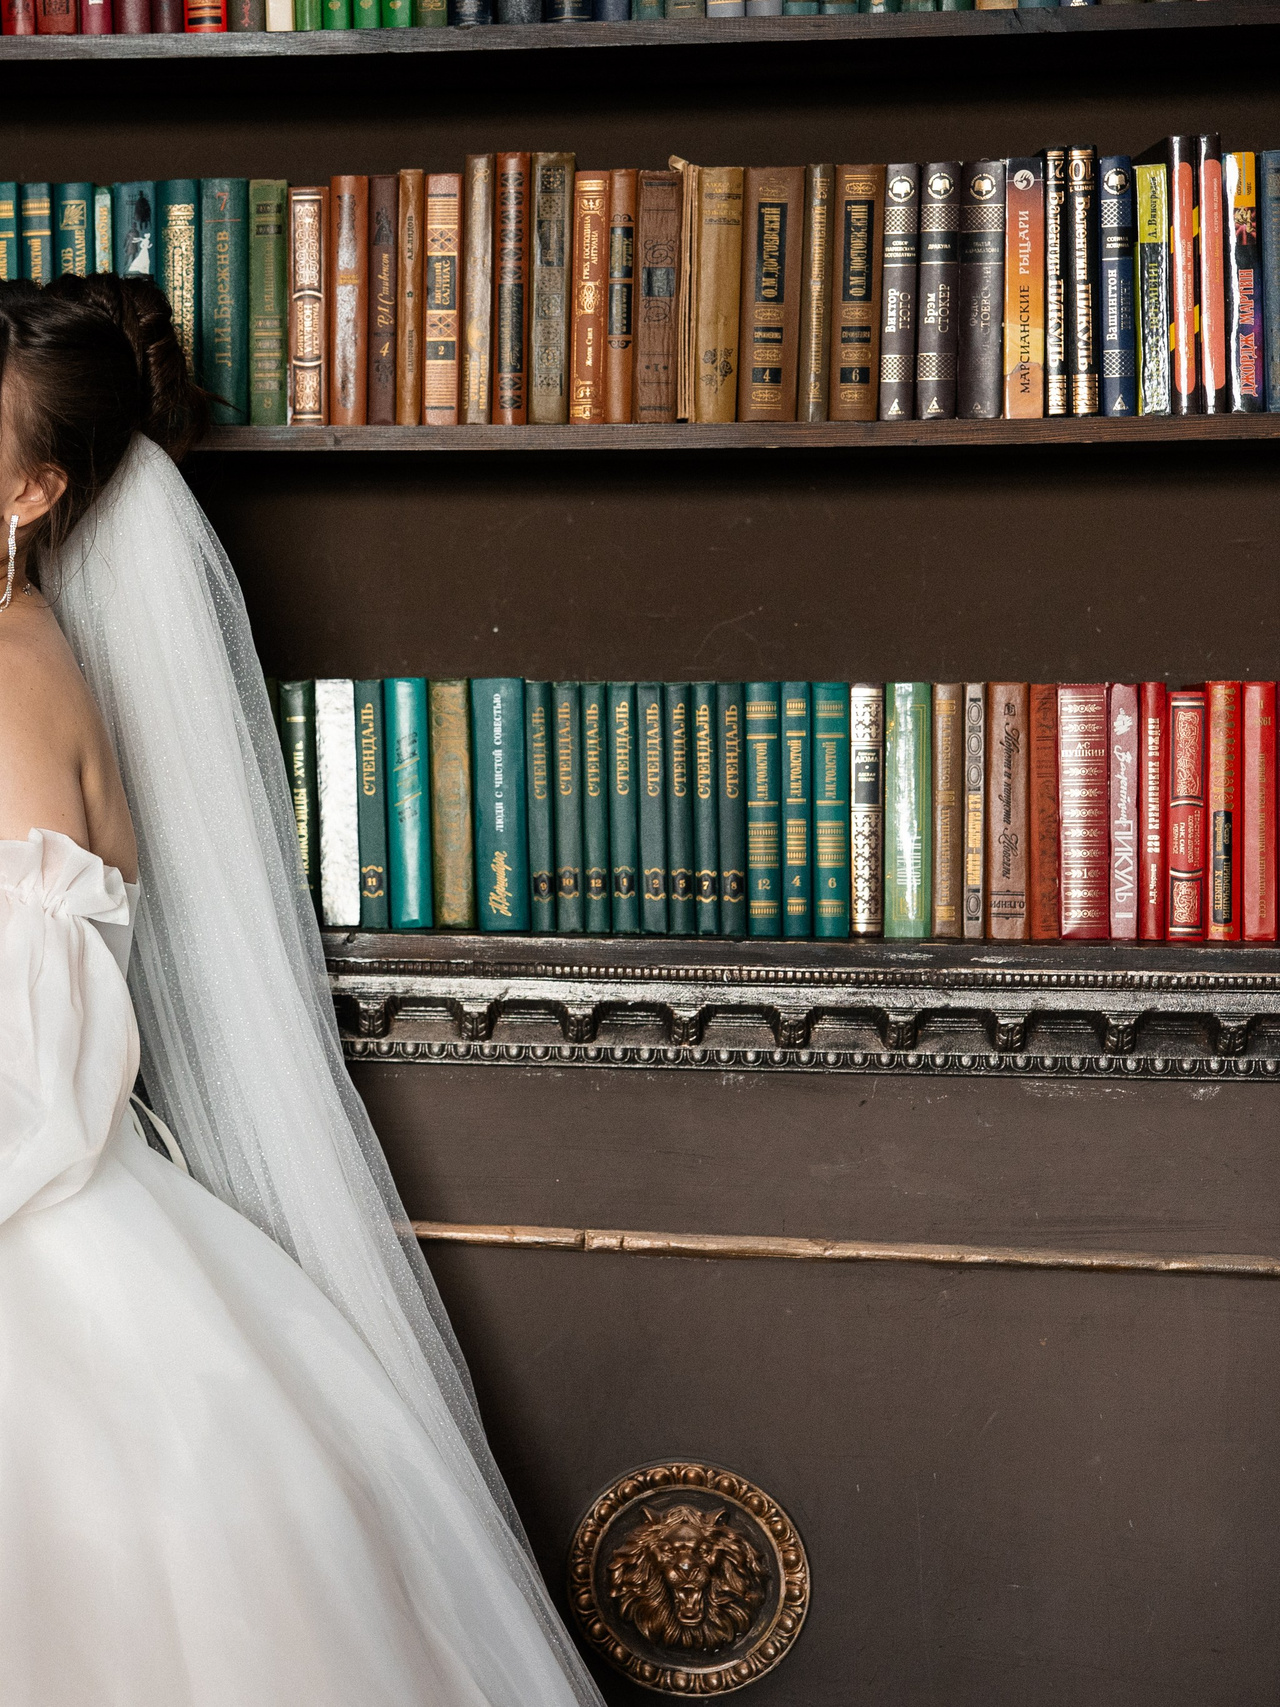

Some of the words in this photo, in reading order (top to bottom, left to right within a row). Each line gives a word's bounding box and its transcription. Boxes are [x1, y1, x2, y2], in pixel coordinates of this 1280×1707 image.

[1068, 159, 1094, 181] 10
[1147, 176, 1160, 225] Виноградов
[61, 247, 73, 275] ХОВ
[761, 206, 782, 298] Ф.М.ДОСТОЕВСКИЙ
[1018, 210, 1031, 275] РЫЦАРИ
[1050, 191, 1064, 275] Валентин
[1076, 195, 1091, 280] Валентин
[1148, 227, 1158, 239] А.
[215, 230, 234, 367] Л.И.Брежнев
[441, 259, 451, 305] САЛИАС
[886, 288, 898, 333] Виктор
[899, 292, 911, 329] ГЮГО
[924, 292, 937, 324] Брэм
[937, 283, 950, 333] СТОКЕР
[1106, 269, 1117, 341] Вашингтон
[1148, 262, 1160, 328] ВРЕМЕНИ
[1239, 268, 1254, 325] МАРТИН
[379, 341, 390, 357] 4
[1019, 285, 1030, 394] МАРСИАНСКИЕ
[1048, 279, 1063, 367] ПИКУЛЬ
[1076, 283, 1092, 371] ПИКУЛЬ
[1239, 332, 1257, 397] ДЖОРДЖ
[492, 693, 502, 745] СОВЕСТЬЮ
[615, 701, 632, 795] СТЕНДАЛЬ
[1147, 717, 1160, 757] ВОЖДЕЙ
[361, 702, 376, 796] СТЕНДАЛЬ
[491, 749, 503, 788] ЧИСТОЙ
[532, 706, 547, 799] СТЕНДАЛЬ
[557, 702, 573, 796] СТЕНДАЛЬ
[586, 703, 602, 797] СТЕНДАЛЬ
[646, 703, 661, 797] СТЕНДАЛЬ
[673, 702, 688, 797] СТЕНДАЛЬ
[696, 705, 712, 799] СТЕНДАЛЬ
[725, 705, 740, 799] СТЕНДАЛЬ
[754, 742, 768, 800] Л.Н.ТОЛСТОЙ
[788, 739, 802, 797] Л.Н.ТОЛСТОЙ
[823, 741, 837, 799] Л.Н.ТОЛСТОЙ
[998, 781, 1011, 824] капуста
[1114, 745, 1132, 826] Валентин
[1148, 760, 1160, 830] КРЕМЛЕВСКИХ
[493, 802, 505, 833] ЛЮДИ
[940, 808, 950, 857] ПУШКИН
[1147, 834, 1159, 854] 229
[757, 878, 770, 891] 12
[791, 875, 802, 887] 4
[827, 877, 837, 888] 6
[1114, 818, 1134, 902] ПИКУЛЬ
[1258, 899, 1267, 918] СССР
